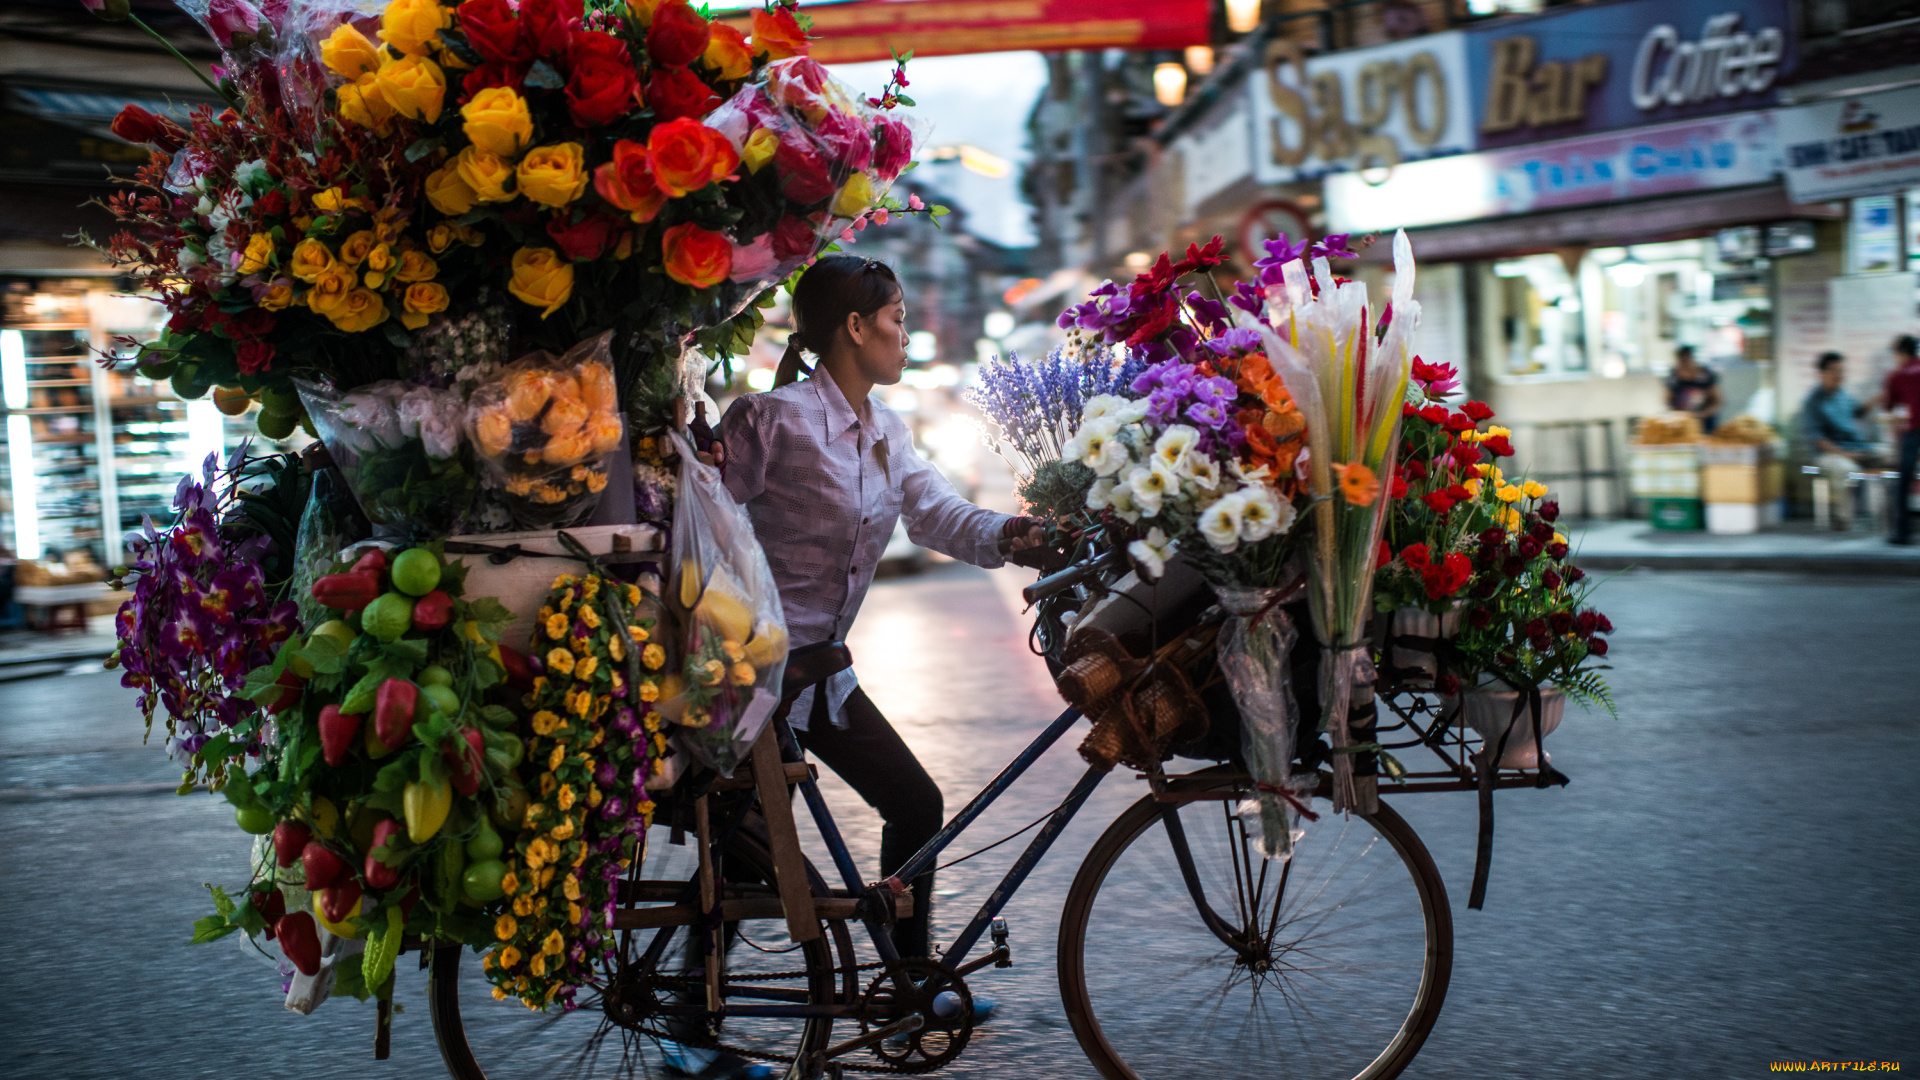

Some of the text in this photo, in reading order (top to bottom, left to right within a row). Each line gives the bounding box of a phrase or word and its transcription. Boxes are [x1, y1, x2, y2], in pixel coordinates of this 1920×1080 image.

[1266, 12, 1784, 187] Sago Bar Coffee
